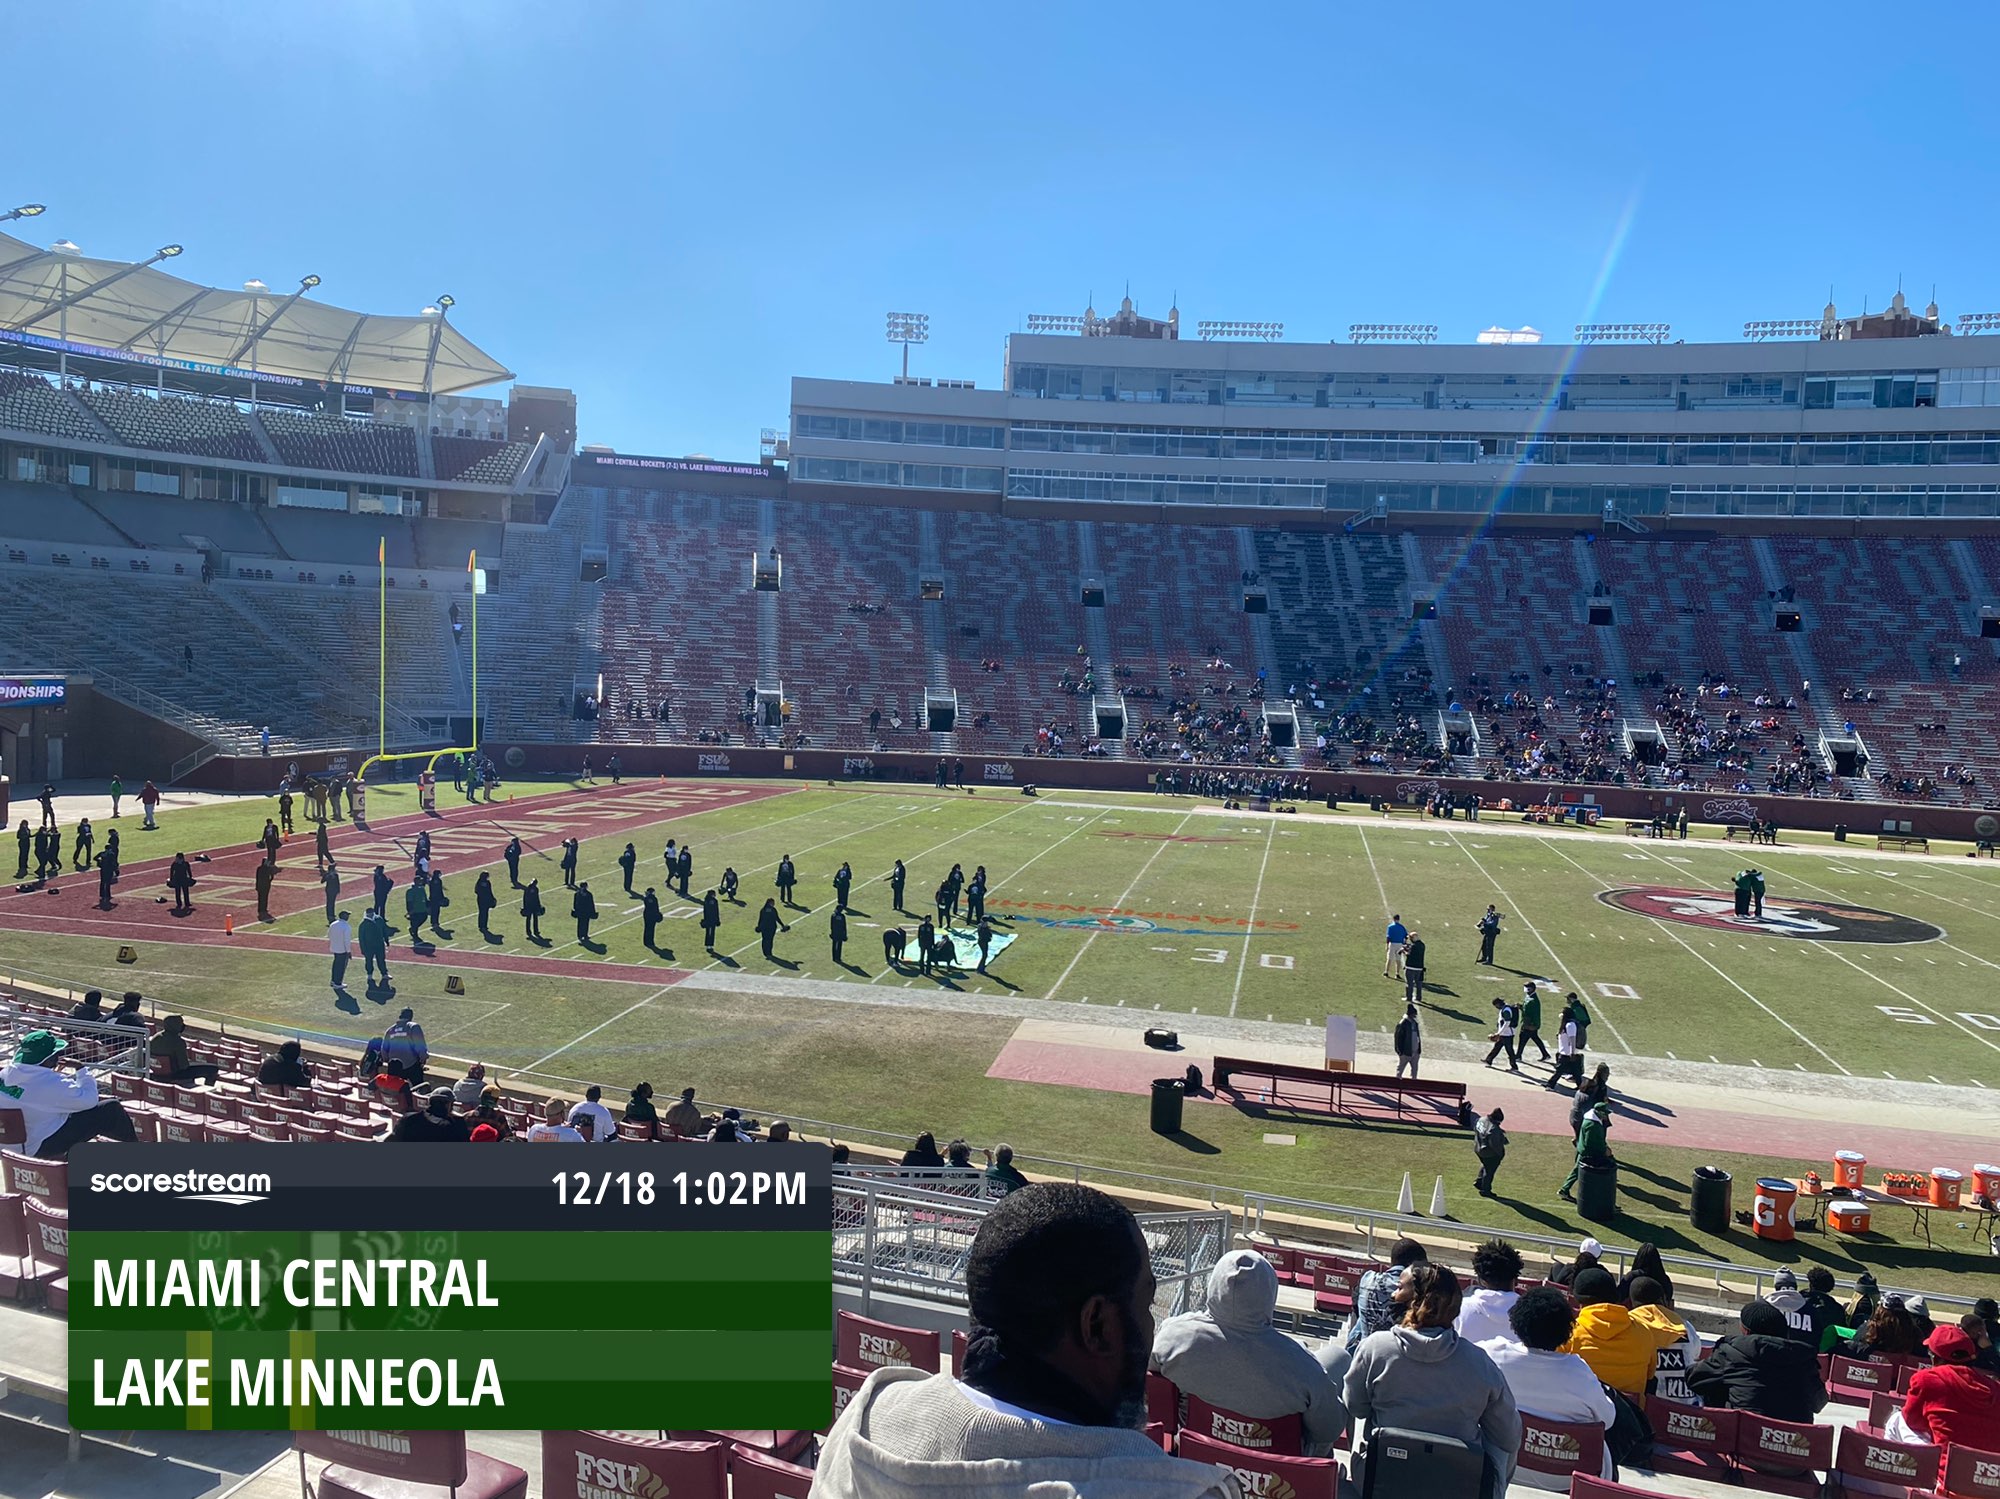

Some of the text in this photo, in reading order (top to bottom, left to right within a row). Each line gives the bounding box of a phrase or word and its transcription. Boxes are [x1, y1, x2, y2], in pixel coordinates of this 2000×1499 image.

[25, 334, 69, 350] FLORIDA
[71, 343, 97, 356] HIGH
[99, 349, 141, 363] SCHOOL
[142, 355, 191, 371] FOOTBALL
[194, 364, 222, 375] STATE
[224, 368, 303, 387] CHAMPIONSHIPS
[343, 384, 373, 395] FHSAA
[596, 456, 614, 465] MIAMI
[615, 458, 639, 467] CENTRAL
[641, 460, 665, 469] ROCKETS
[689, 463, 703, 471] LAKE
[704, 464, 732, 473] MINNEOLA
[733, 466, 752, 475] HAWKS
[698, 754, 721, 765] FSU
[843, 757, 865, 768] FSU
[984, 763, 1005, 774] FSU
[448, 975, 459, 989] 10
[13, 1167, 37, 1184] FSU
[1847, 1166, 1857, 1175] G
[1948, 1184, 1958, 1194] G
[1989, 1180, 1999, 1190] G
[1754, 1195, 1775, 1227] G
[1851, 1215, 1861, 1226] G
[1325, 1274, 1343, 1283] FSU
[859, 1332, 896, 1356] FSU
[859, 1349, 912, 1367] Credit Union
[1847, 1365, 1870, 1376] FSU
[1212, 1411, 1254, 1438] FSU
[1667, 1411, 1703, 1429] FSU
[1211, 1426, 1272, 1448] Credit Union
[1525, 1426, 1566, 1449] FSU
[1666, 1424, 1716, 1441] Credit Union
[1760, 1426, 1797, 1445] FSU
[370, 1430, 412, 1454] Union
[1524, 1442, 1580, 1460] Credit Union
[1759, 1439, 1810, 1457] Credit Union
[1866, 1445, 1904, 1466] FSU
[575, 1450, 641, 1494] FSU
[1864, 1458, 1917, 1477] Credit Union
[1975, 1460, 2000, 1478] FS
[1973, 1474, 2000, 1487] Credit
